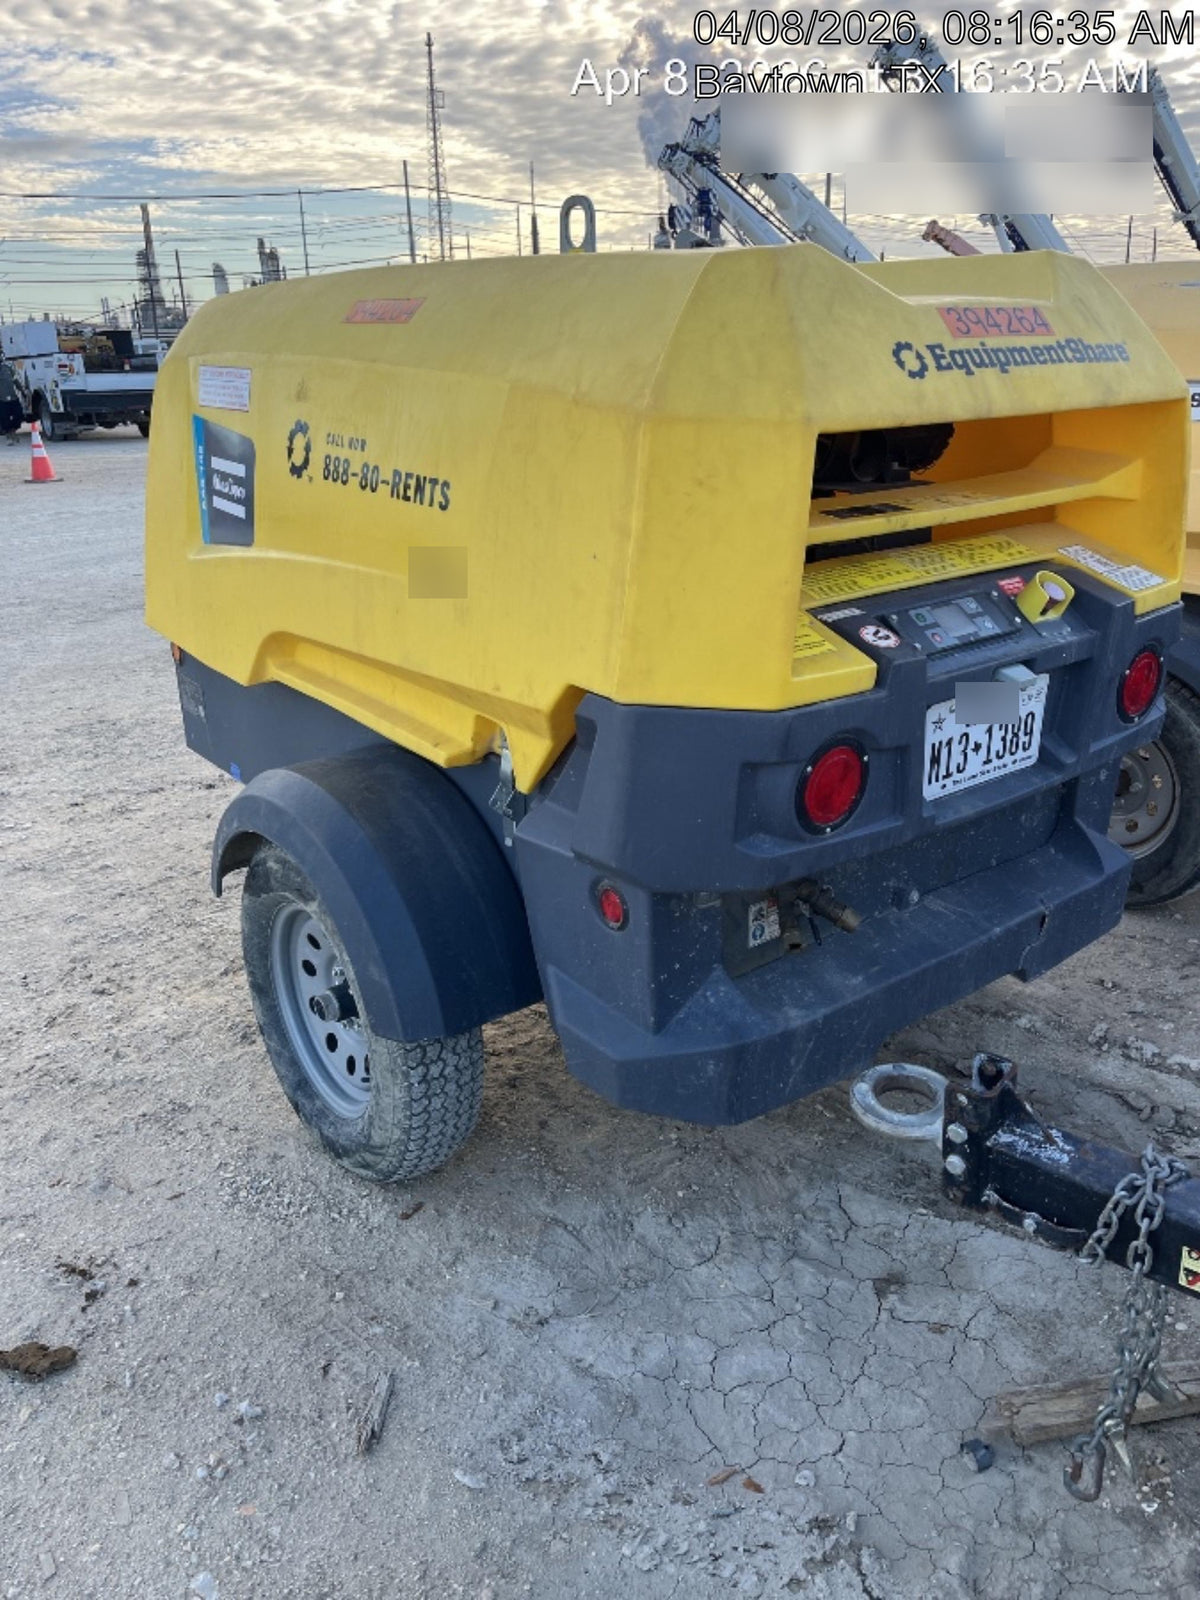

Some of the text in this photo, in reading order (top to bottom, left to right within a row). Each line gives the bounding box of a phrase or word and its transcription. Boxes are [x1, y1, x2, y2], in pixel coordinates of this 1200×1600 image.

[946, 306, 1051, 337] 394264
[925, 337, 1131, 376] EquipmentShare
[323, 453, 451, 512] 888-80-RENTS
